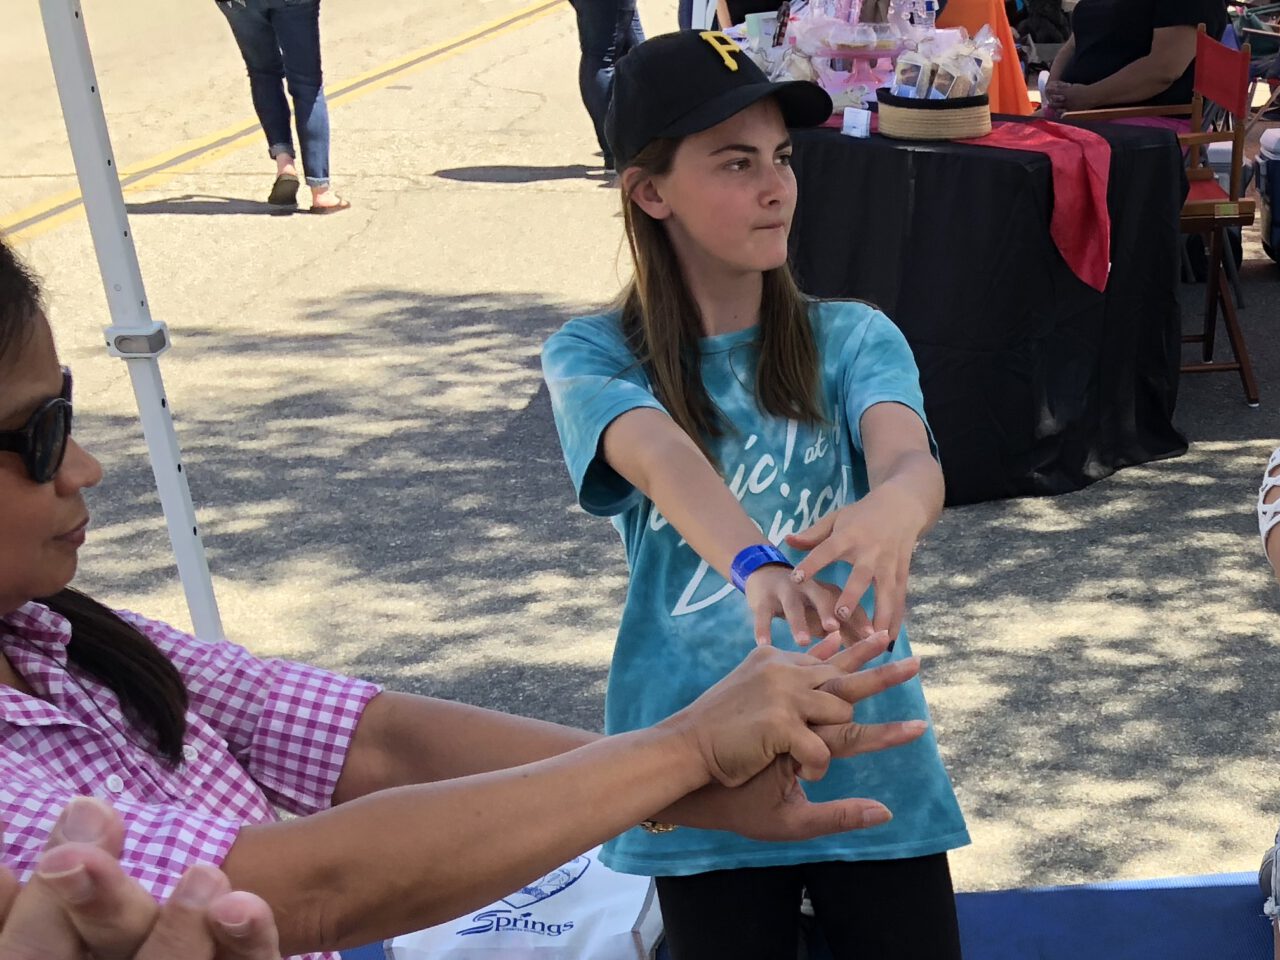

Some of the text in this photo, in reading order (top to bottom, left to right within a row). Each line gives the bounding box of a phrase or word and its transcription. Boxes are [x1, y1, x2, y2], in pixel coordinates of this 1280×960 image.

[698, 30, 740, 72] P
[804, 429, 829, 465] at
[456, 909, 574, 937] Springs
